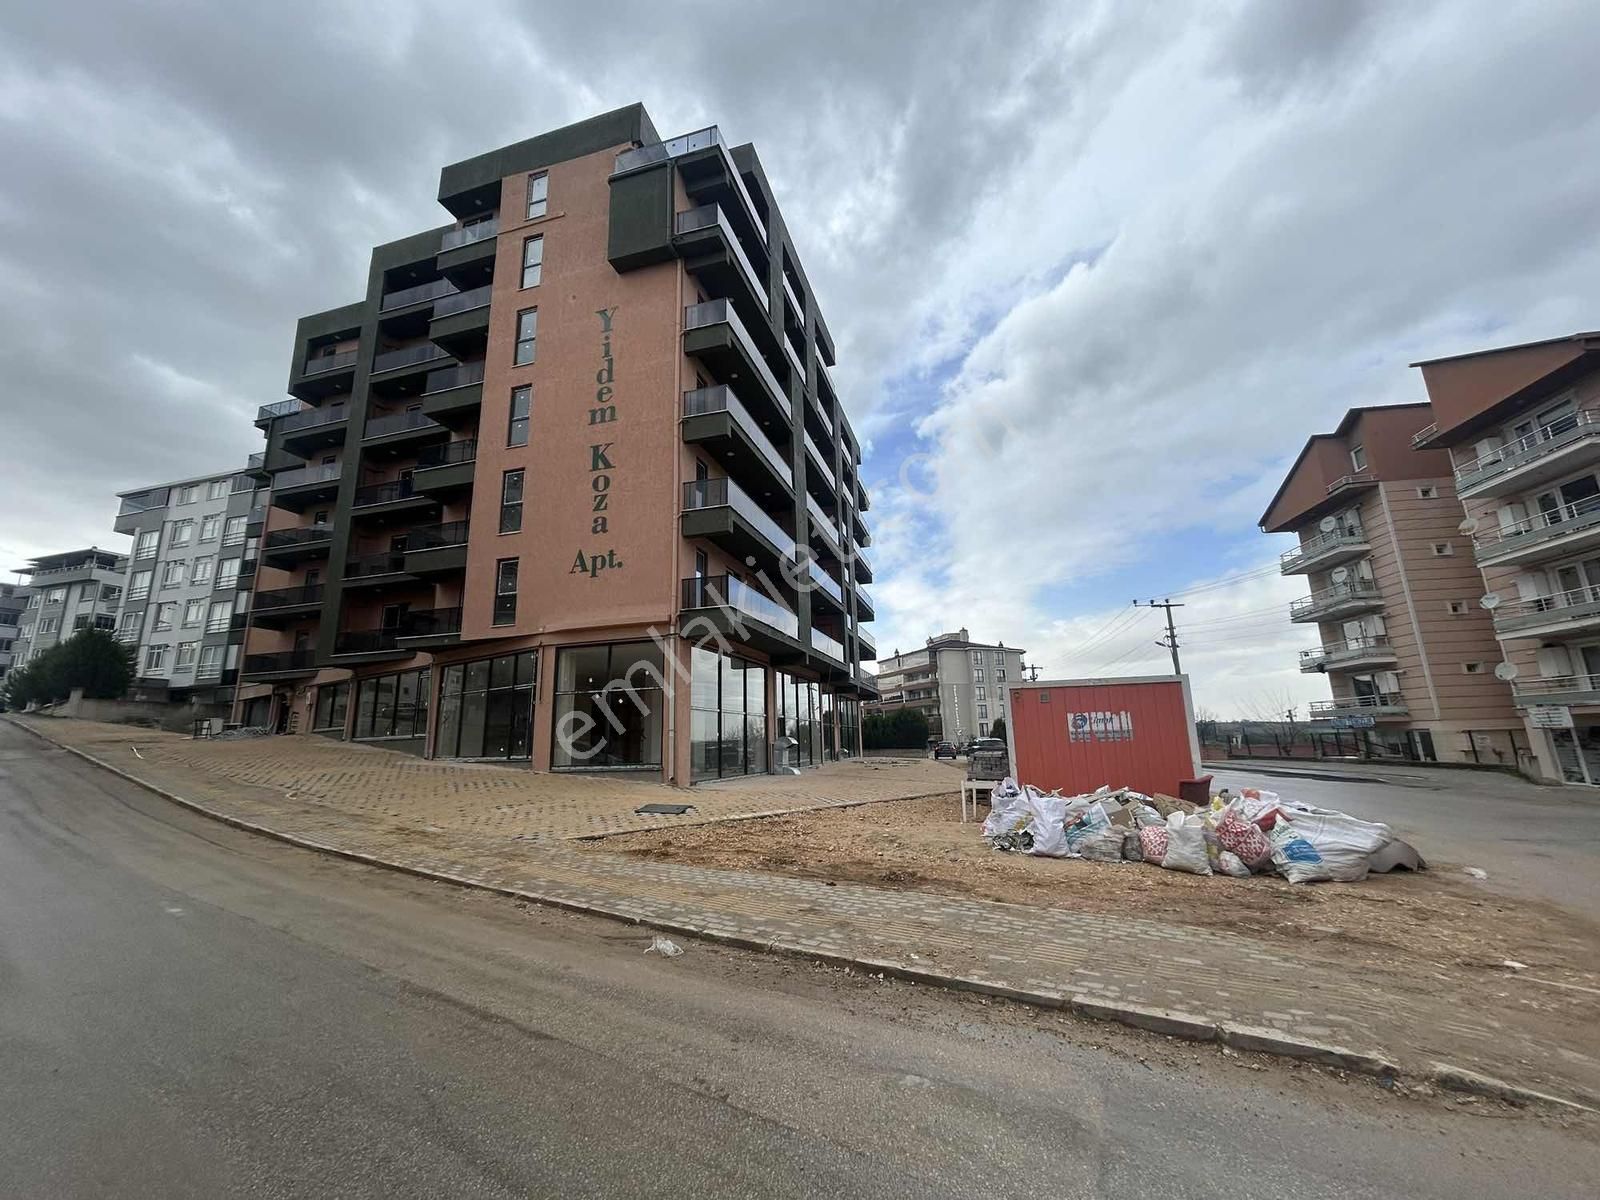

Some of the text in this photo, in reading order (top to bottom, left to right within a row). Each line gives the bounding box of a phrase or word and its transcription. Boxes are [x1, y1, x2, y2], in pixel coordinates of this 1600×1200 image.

[587, 305, 619, 535] Yidem Koza
[568, 548, 624, 579] Apt.
